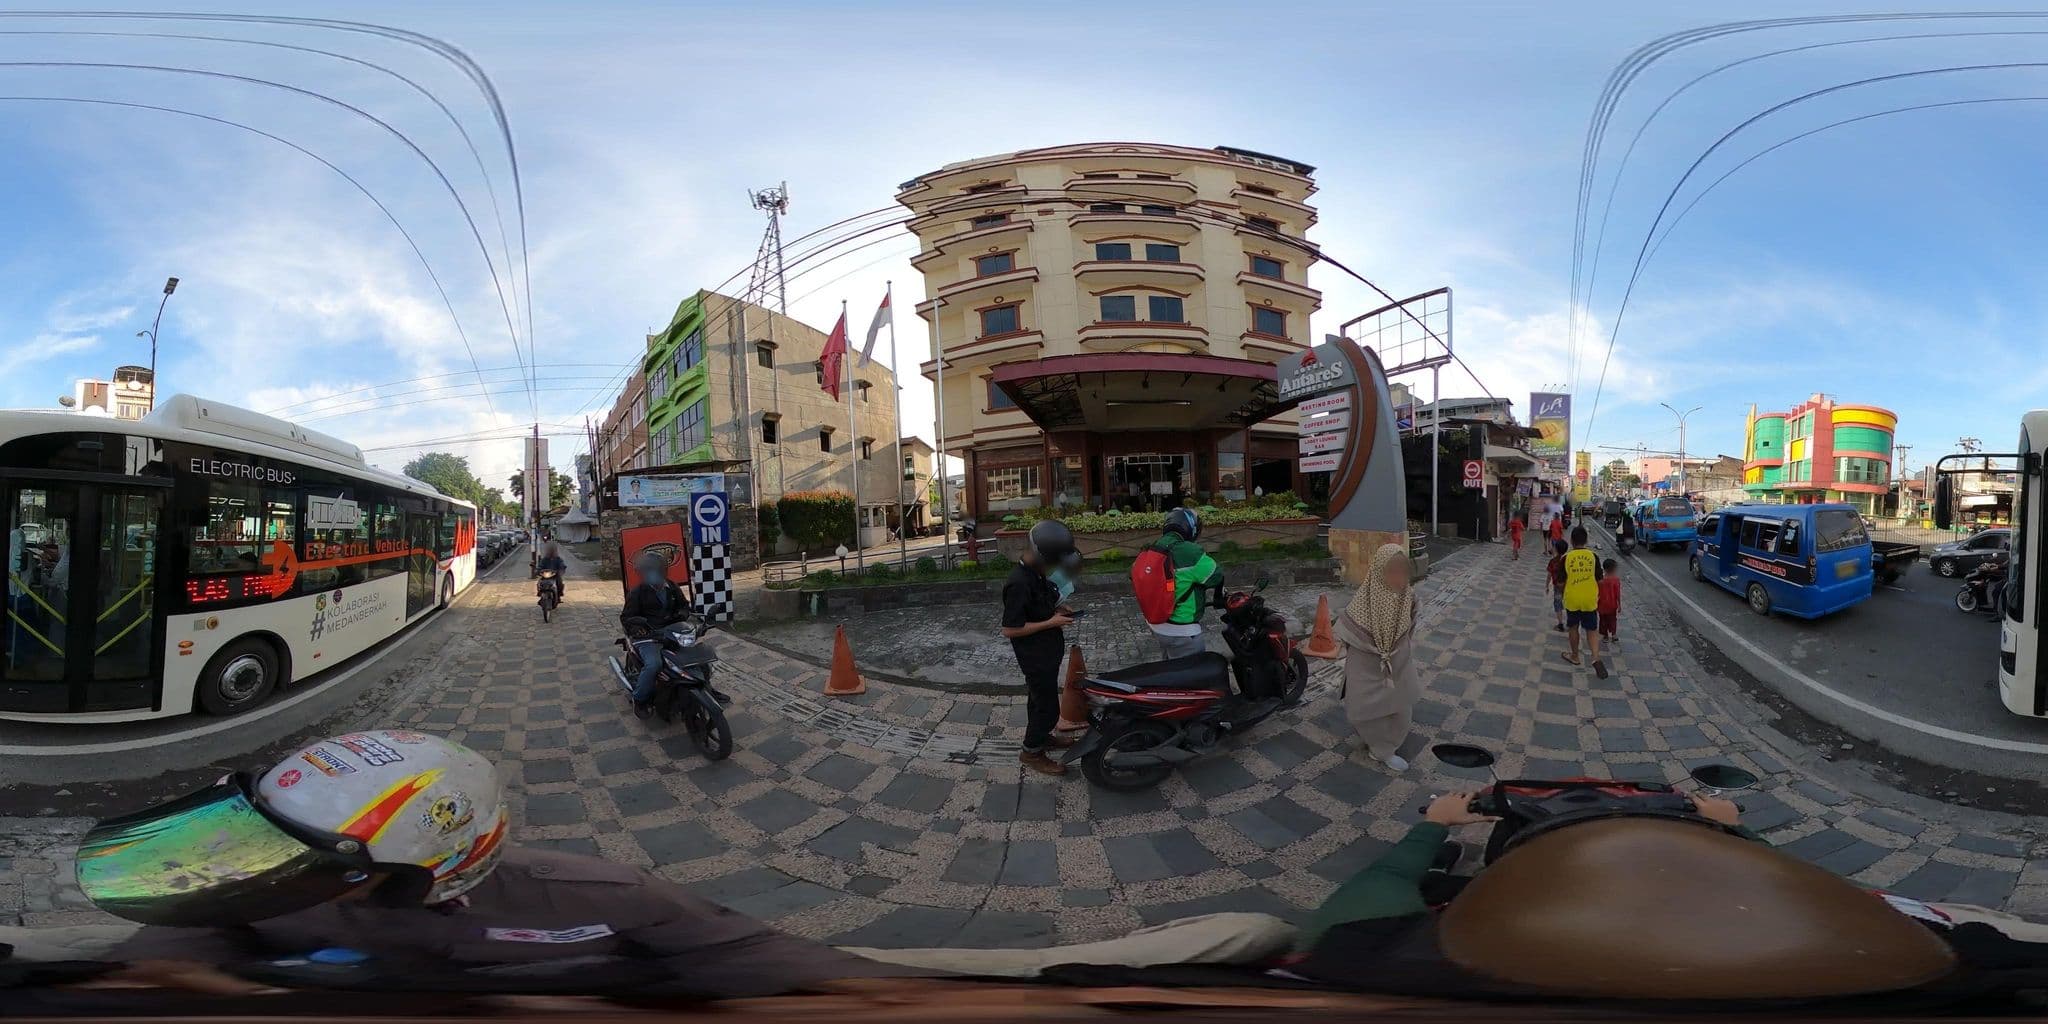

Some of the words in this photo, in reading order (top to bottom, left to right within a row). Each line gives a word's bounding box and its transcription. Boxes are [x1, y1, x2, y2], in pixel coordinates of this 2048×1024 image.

[1287, 382, 1333, 398] INDONESIA
[1301, 401, 1326, 411] MEETING
[1327, 398, 1345, 407] ROOM
[1540, 398, 1562, 415] LA
[1303, 421, 1324, 429] COFFEE
[1325, 418, 1341, 427] SHOP
[190, 458, 264, 480] ELECTRIC
[1463, 479, 1482, 488] OUT
[701, 527, 722, 543] IN
[327, 592, 380, 618] KOLABORASI
[326, 602, 387, 633] MEDANBERKAH
